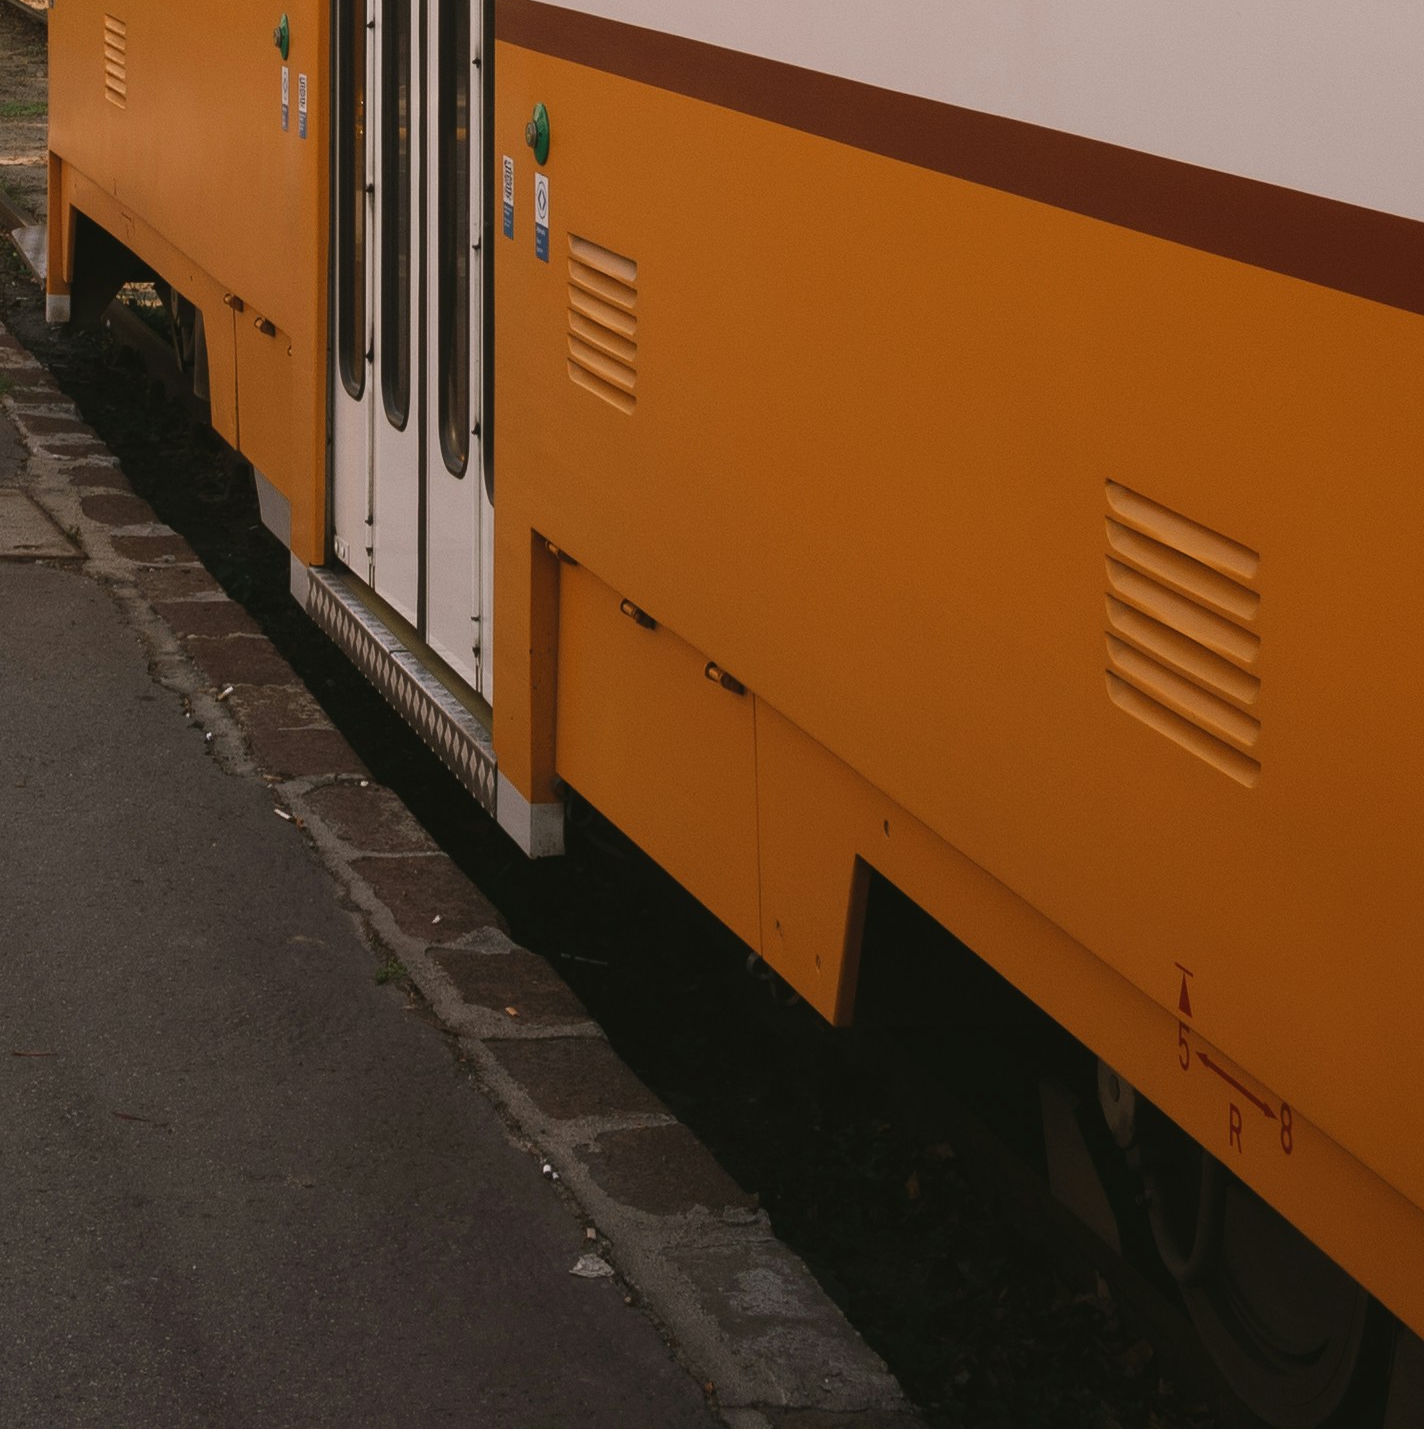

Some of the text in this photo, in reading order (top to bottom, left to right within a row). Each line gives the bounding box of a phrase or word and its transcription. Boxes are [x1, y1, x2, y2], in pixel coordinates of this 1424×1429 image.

[1178, 1020, 1293, 1156] 5 8
[1229, 1102, 1243, 1155] R
